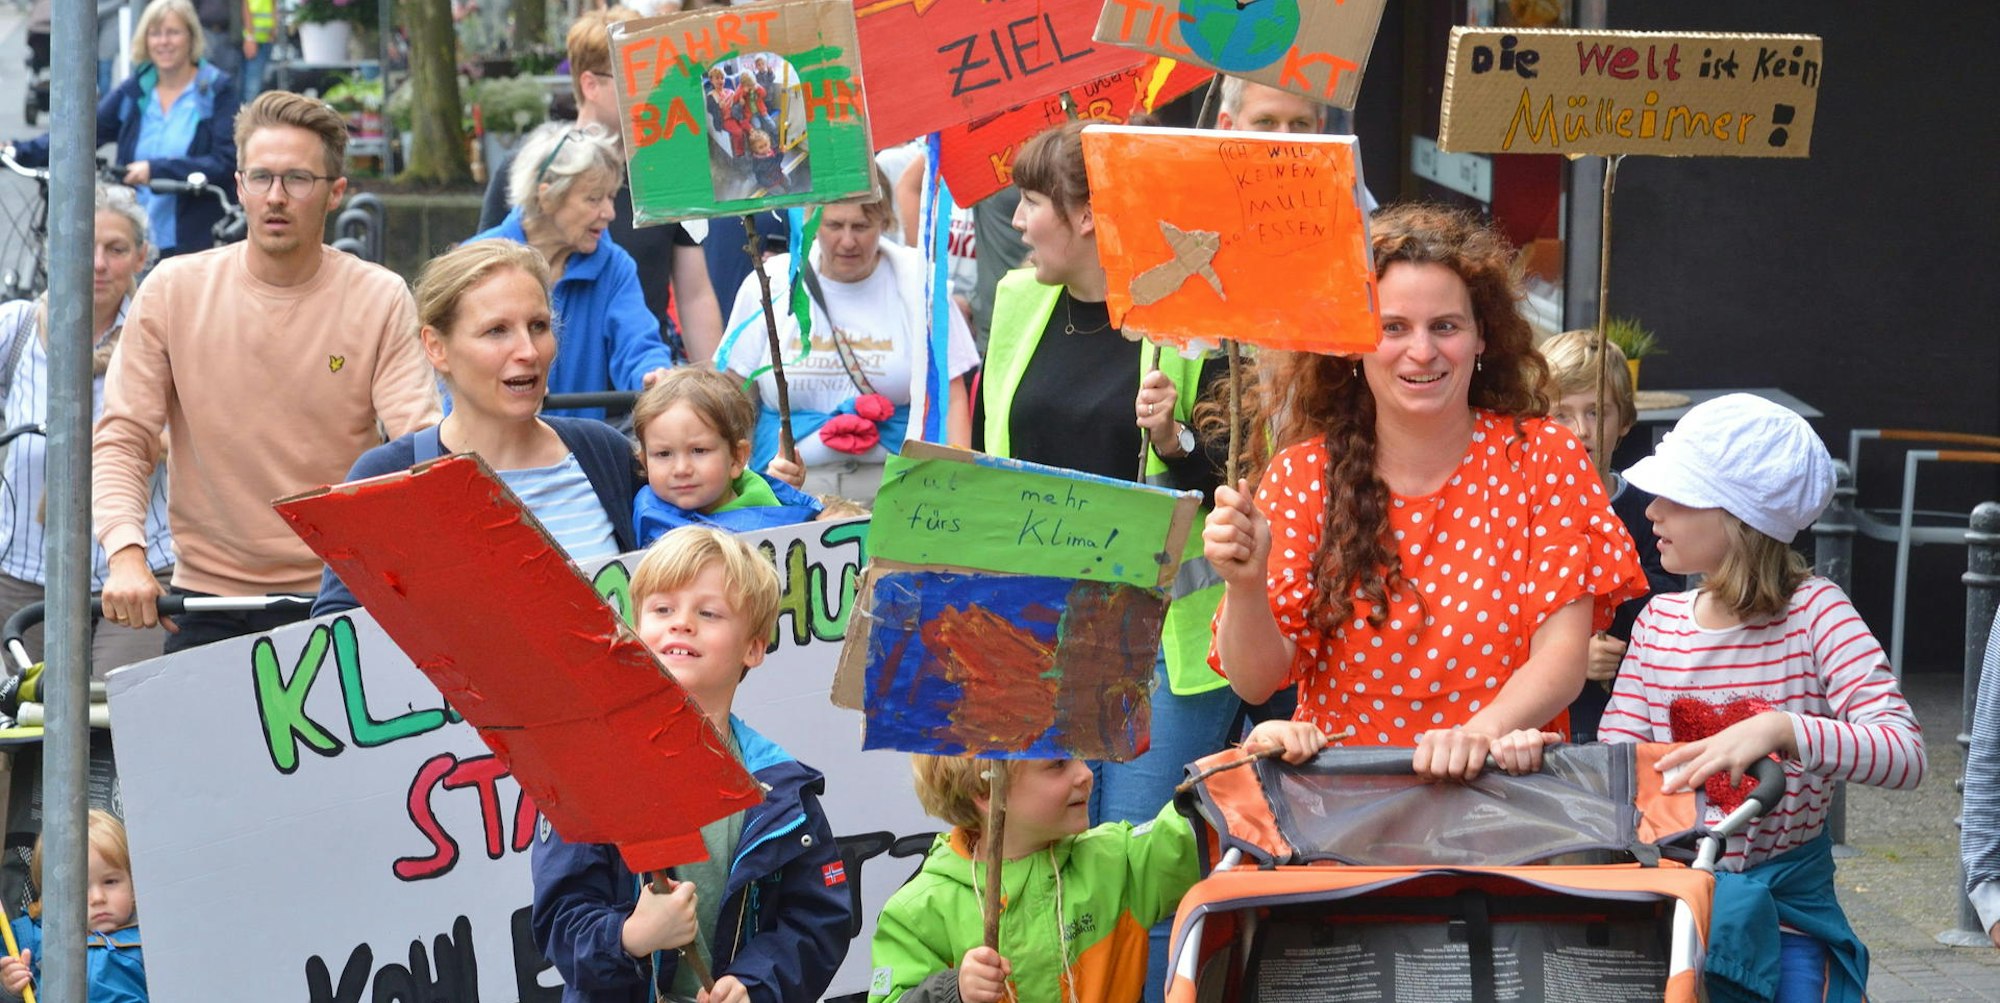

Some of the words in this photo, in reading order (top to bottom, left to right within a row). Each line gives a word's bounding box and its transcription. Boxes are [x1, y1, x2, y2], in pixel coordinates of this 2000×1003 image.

[621, 11, 780, 98] FAHRT
[938, 13, 1096, 97] ZIEL
[1471, 34, 1540, 80] Die
[1576, 41, 1682, 81] Welt
[1699, 48, 1740, 80] ist
[1223, 146, 1248, 161] ICH
[1266, 145, 1308, 159] WILL
[1236, 163, 1317, 190] KEINEN
[1250, 184, 1328, 216] MÜLL
[1258, 220, 1327, 245] ESSEN
[1020, 483, 1089, 511] mehr
[907, 503, 961, 532] fürs
